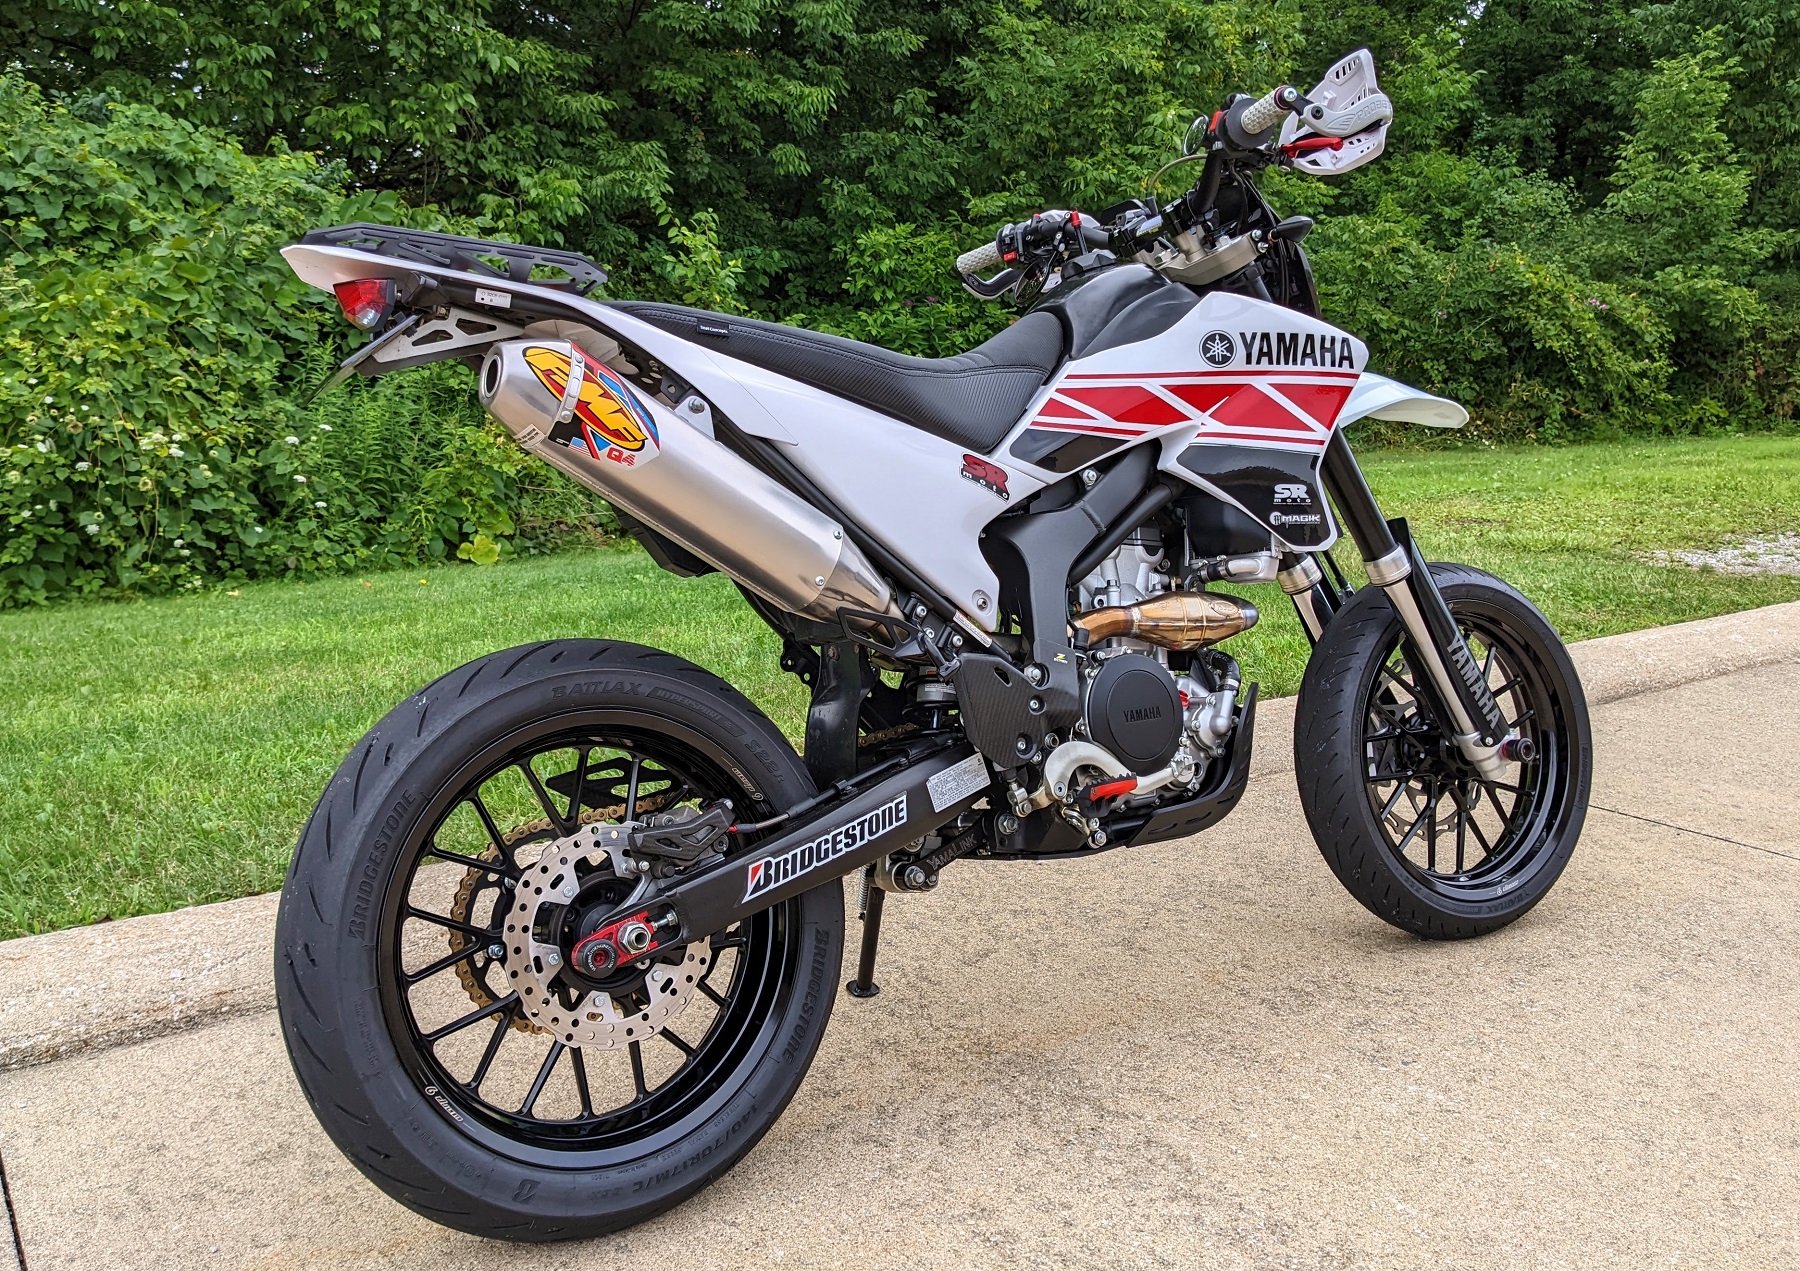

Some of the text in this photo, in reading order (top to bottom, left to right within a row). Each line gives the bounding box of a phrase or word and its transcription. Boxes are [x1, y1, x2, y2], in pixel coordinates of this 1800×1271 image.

[1239, 332, 1355, 369] YAMAHA
[525, 350, 648, 442] FMF
[606, 447, 636, 467] Q4
[963, 454, 1009, 492] SR
[962, 471, 1008, 499] moto
[1274, 484, 1310, 499] SR
[1281, 514, 1320, 526] MAGIK
[551, 681, 643, 700] BATTLAX
[1447, 635, 1501, 730] YAMAHA
[1123, 706, 1162, 723] YAMAHA
[347, 789, 416, 941] BRIDGESTONE
[743, 796, 907, 903] BRIDGESTONE
[782, 927, 830, 1065] BRIDGESTONE
